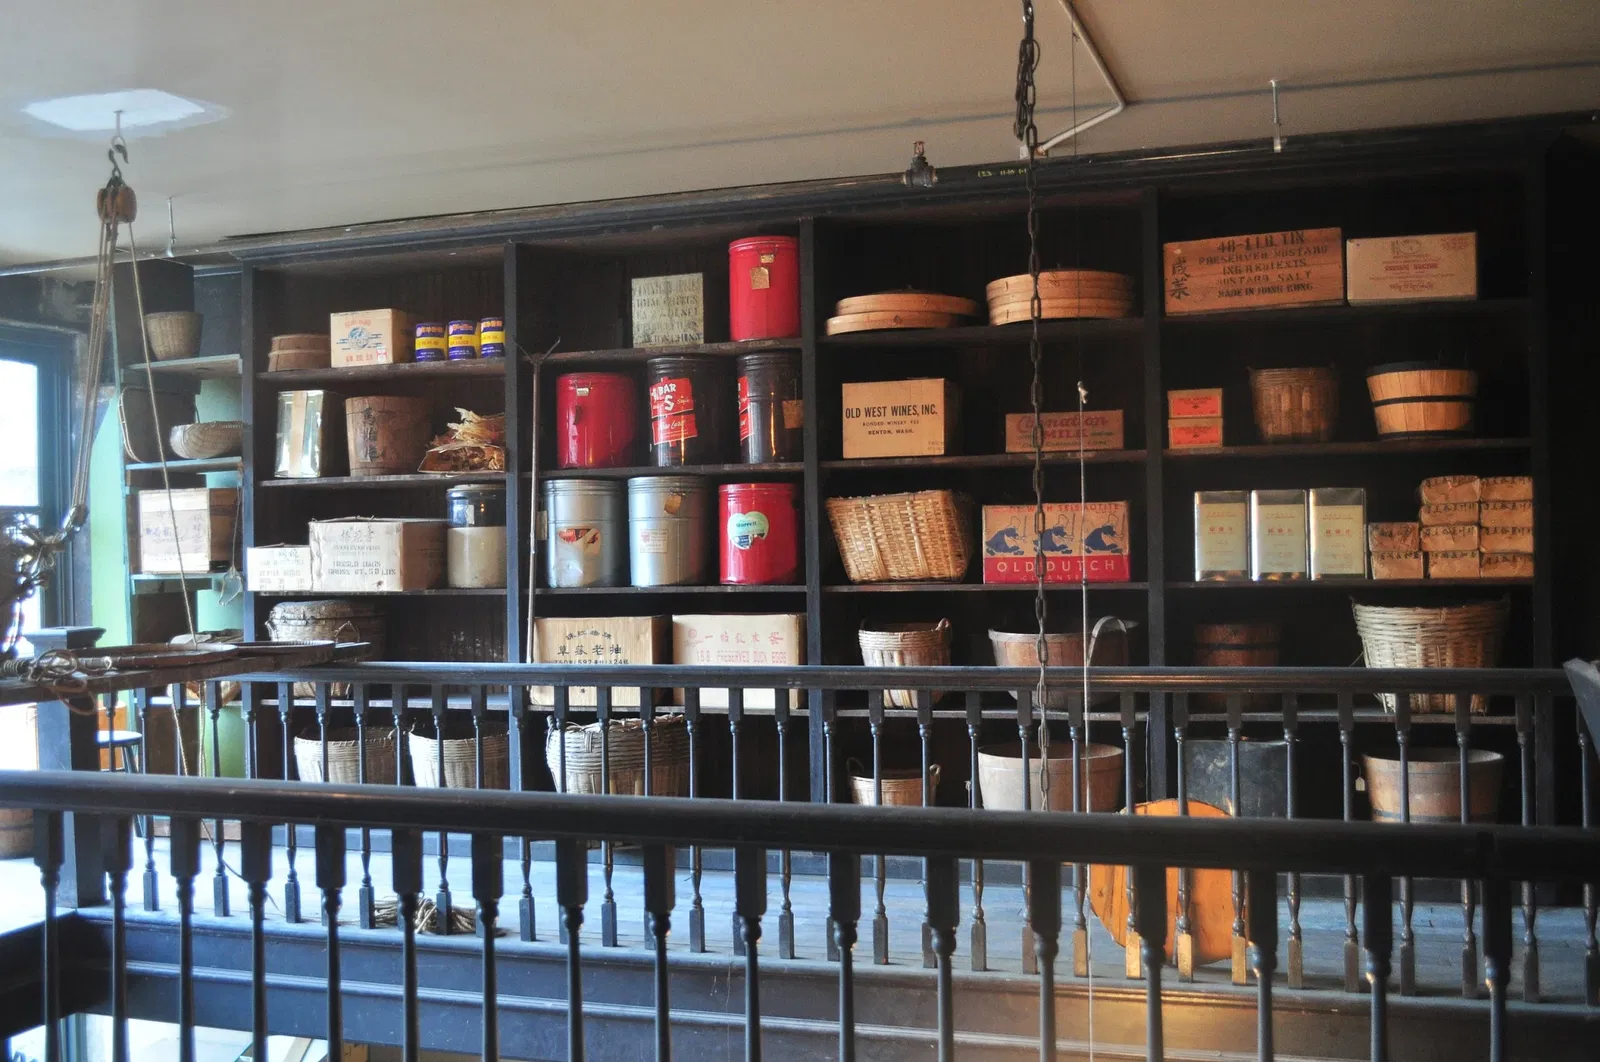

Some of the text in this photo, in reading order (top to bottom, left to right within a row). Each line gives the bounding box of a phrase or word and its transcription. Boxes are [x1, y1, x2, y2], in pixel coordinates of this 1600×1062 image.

[1278, 269, 1312, 282] SALT
[1245, 286, 1255, 295] IN
[658, 383, 677, 395] BAR
[664, 394, 675, 411] S
[845, 403, 938, 419] OLD WEST WINES, INC.
[1028, 503, 1053, 512] WH
[996, 559, 1115, 573] OLD DUTCH
